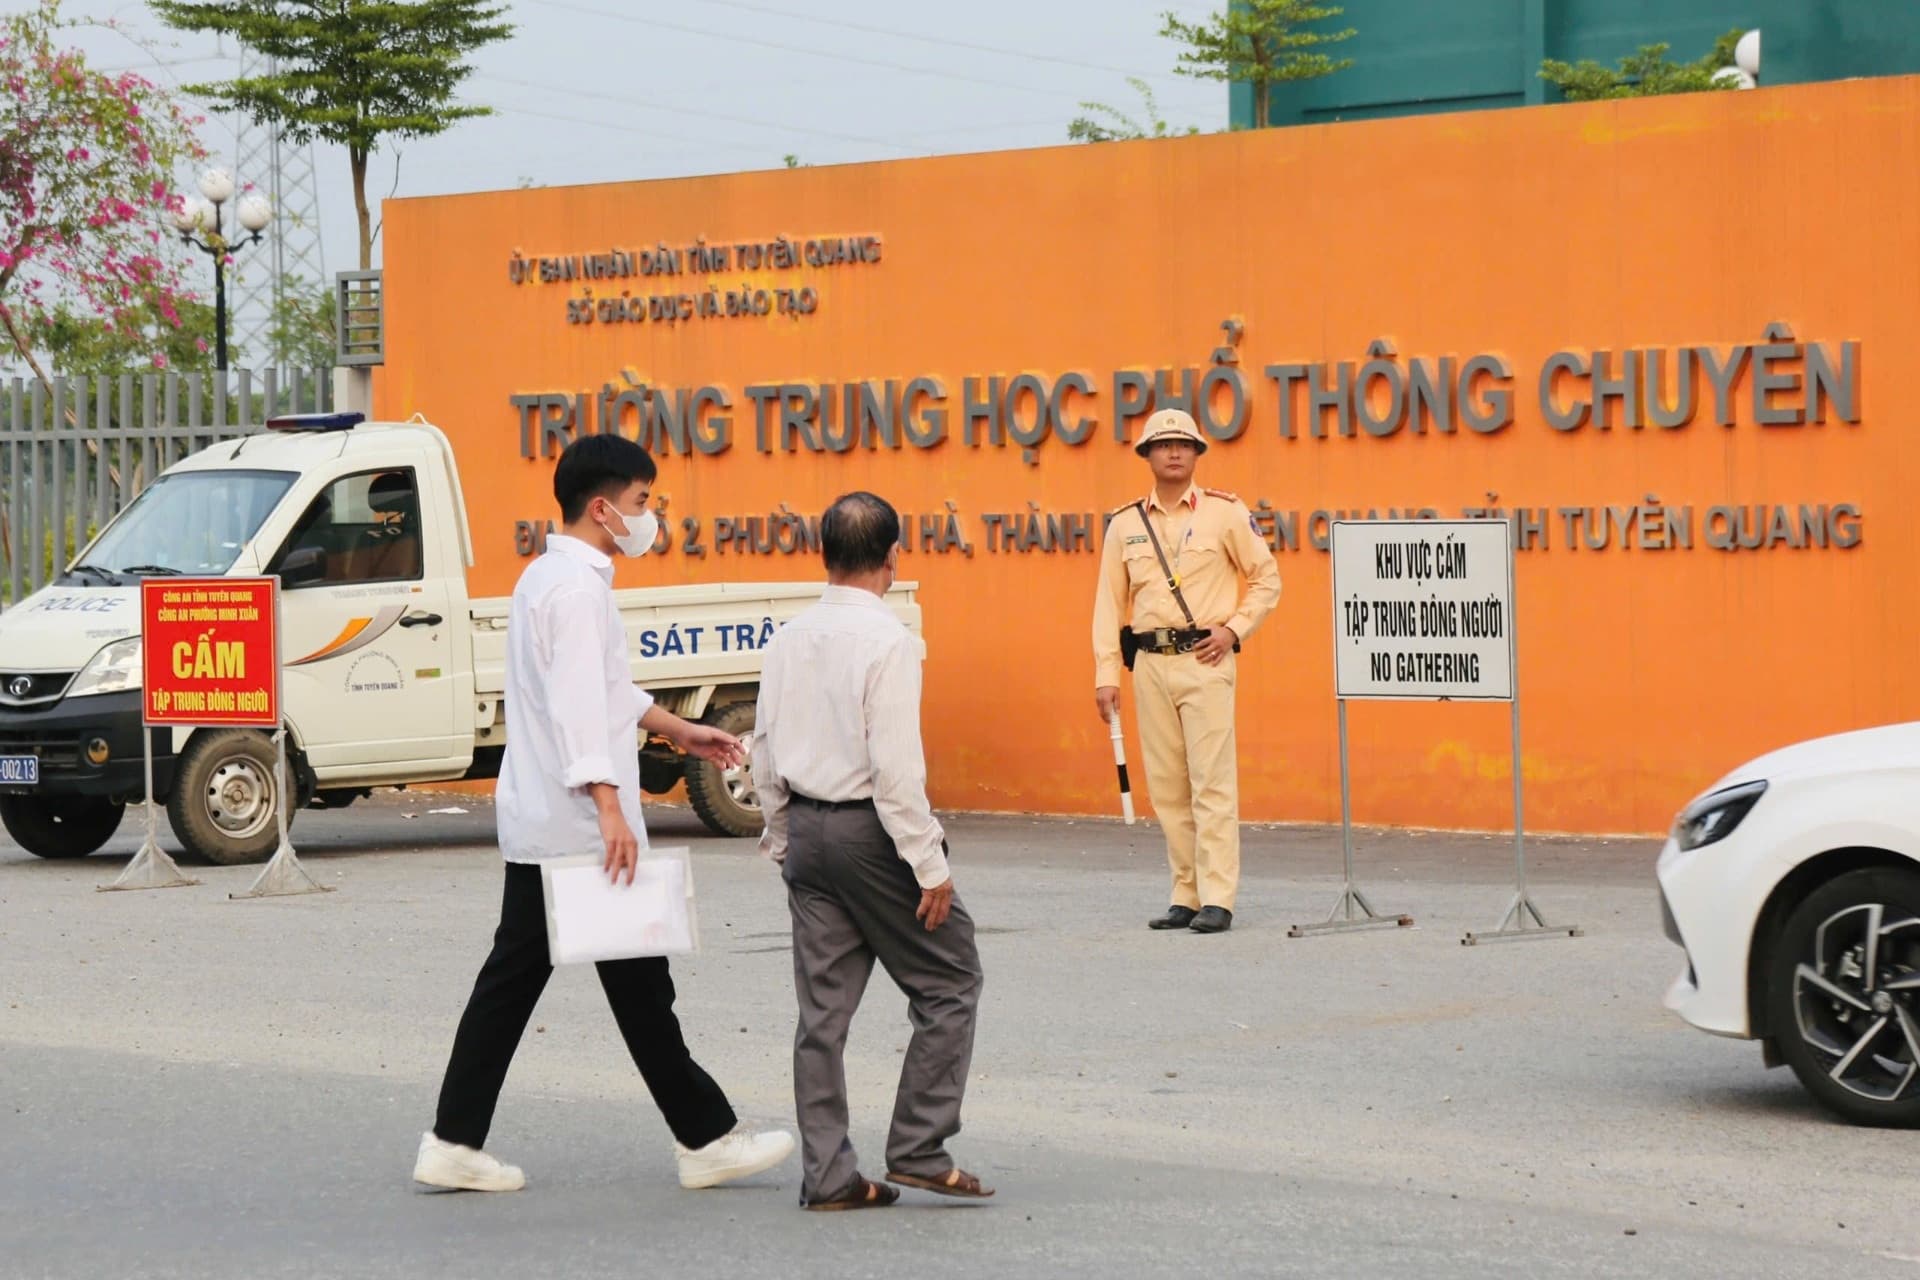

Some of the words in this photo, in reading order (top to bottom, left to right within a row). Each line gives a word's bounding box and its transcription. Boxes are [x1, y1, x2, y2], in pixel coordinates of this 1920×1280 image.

[509, 248, 537, 285] ỦY
[539, 256, 581, 283] BAN
[583, 248, 638, 280] NHÂN
[640, 242, 683, 276] DÂN
[687, 235, 731, 274] TỈNH
[734, 233, 802, 270] TUYÊN
[804, 236, 882, 268] QUANG
[567, 288, 595, 324] SỞ
[597, 290, 647, 323] GIÁO
[648, 294, 692, 328] DỤC
[695, 284, 724, 319] VÀ
[725, 283, 771, 318] ĐÀO
[774, 287, 818, 322] TẠO
[511, 366, 733, 458] TRƯỜNG
[744, 377, 948, 453] TRUNG
[963, 371, 1098, 465] HỌC
[1113, 318, 1253, 442] PHỔ
[1265, 338, 1514, 437] THÔNG
[1538, 321, 1862, 432] CHUYÊN
[682, 517, 706, 560] 2,
[715, 502, 822, 554] PHƯỜN
[920, 499, 974, 558] HÀ,
[981, 500, 1094, 553] THÀNH
[1558, 494, 1694, 552] TUYÊN
[1704, 503, 1862, 551] QUANG
[1376, 543, 1401, 579] KHU
[1406, 539, 1432, 586] VỰC
[1436, 533, 1466, 579] CẤM
[28, 597, 126, 612] POLICE
[158, 606, 177, 621] CÔNG
[178, 608, 188, 621] AN
[238, 605, 258, 621] XUÂN
[163, 590, 181, 603] CÔNG
[182, 592, 191, 603] AN
[208, 589, 229, 603] TUYÊN
[230, 591, 252, 603] QUANG
[640, 623, 704, 658] SÁT
[1344, 593, 1369, 645] TẬP
[1373, 601, 1416, 637] TRUNG
[1420, 593, 1457, 638] ĐÔNG
[1461, 593, 1503, 638] NGƯỜI
[172, 628, 245, 679] CẤM
[1371, 652, 1391, 682] NO
[1396, 652, 1480, 683] GATHERING
[152, 687, 170, 715] TẬP
[173, 691, 206, 712] TRUNG
[207, 687, 235, 712] ĐÔNG
[237, 687, 269, 712] NGƯỜI
